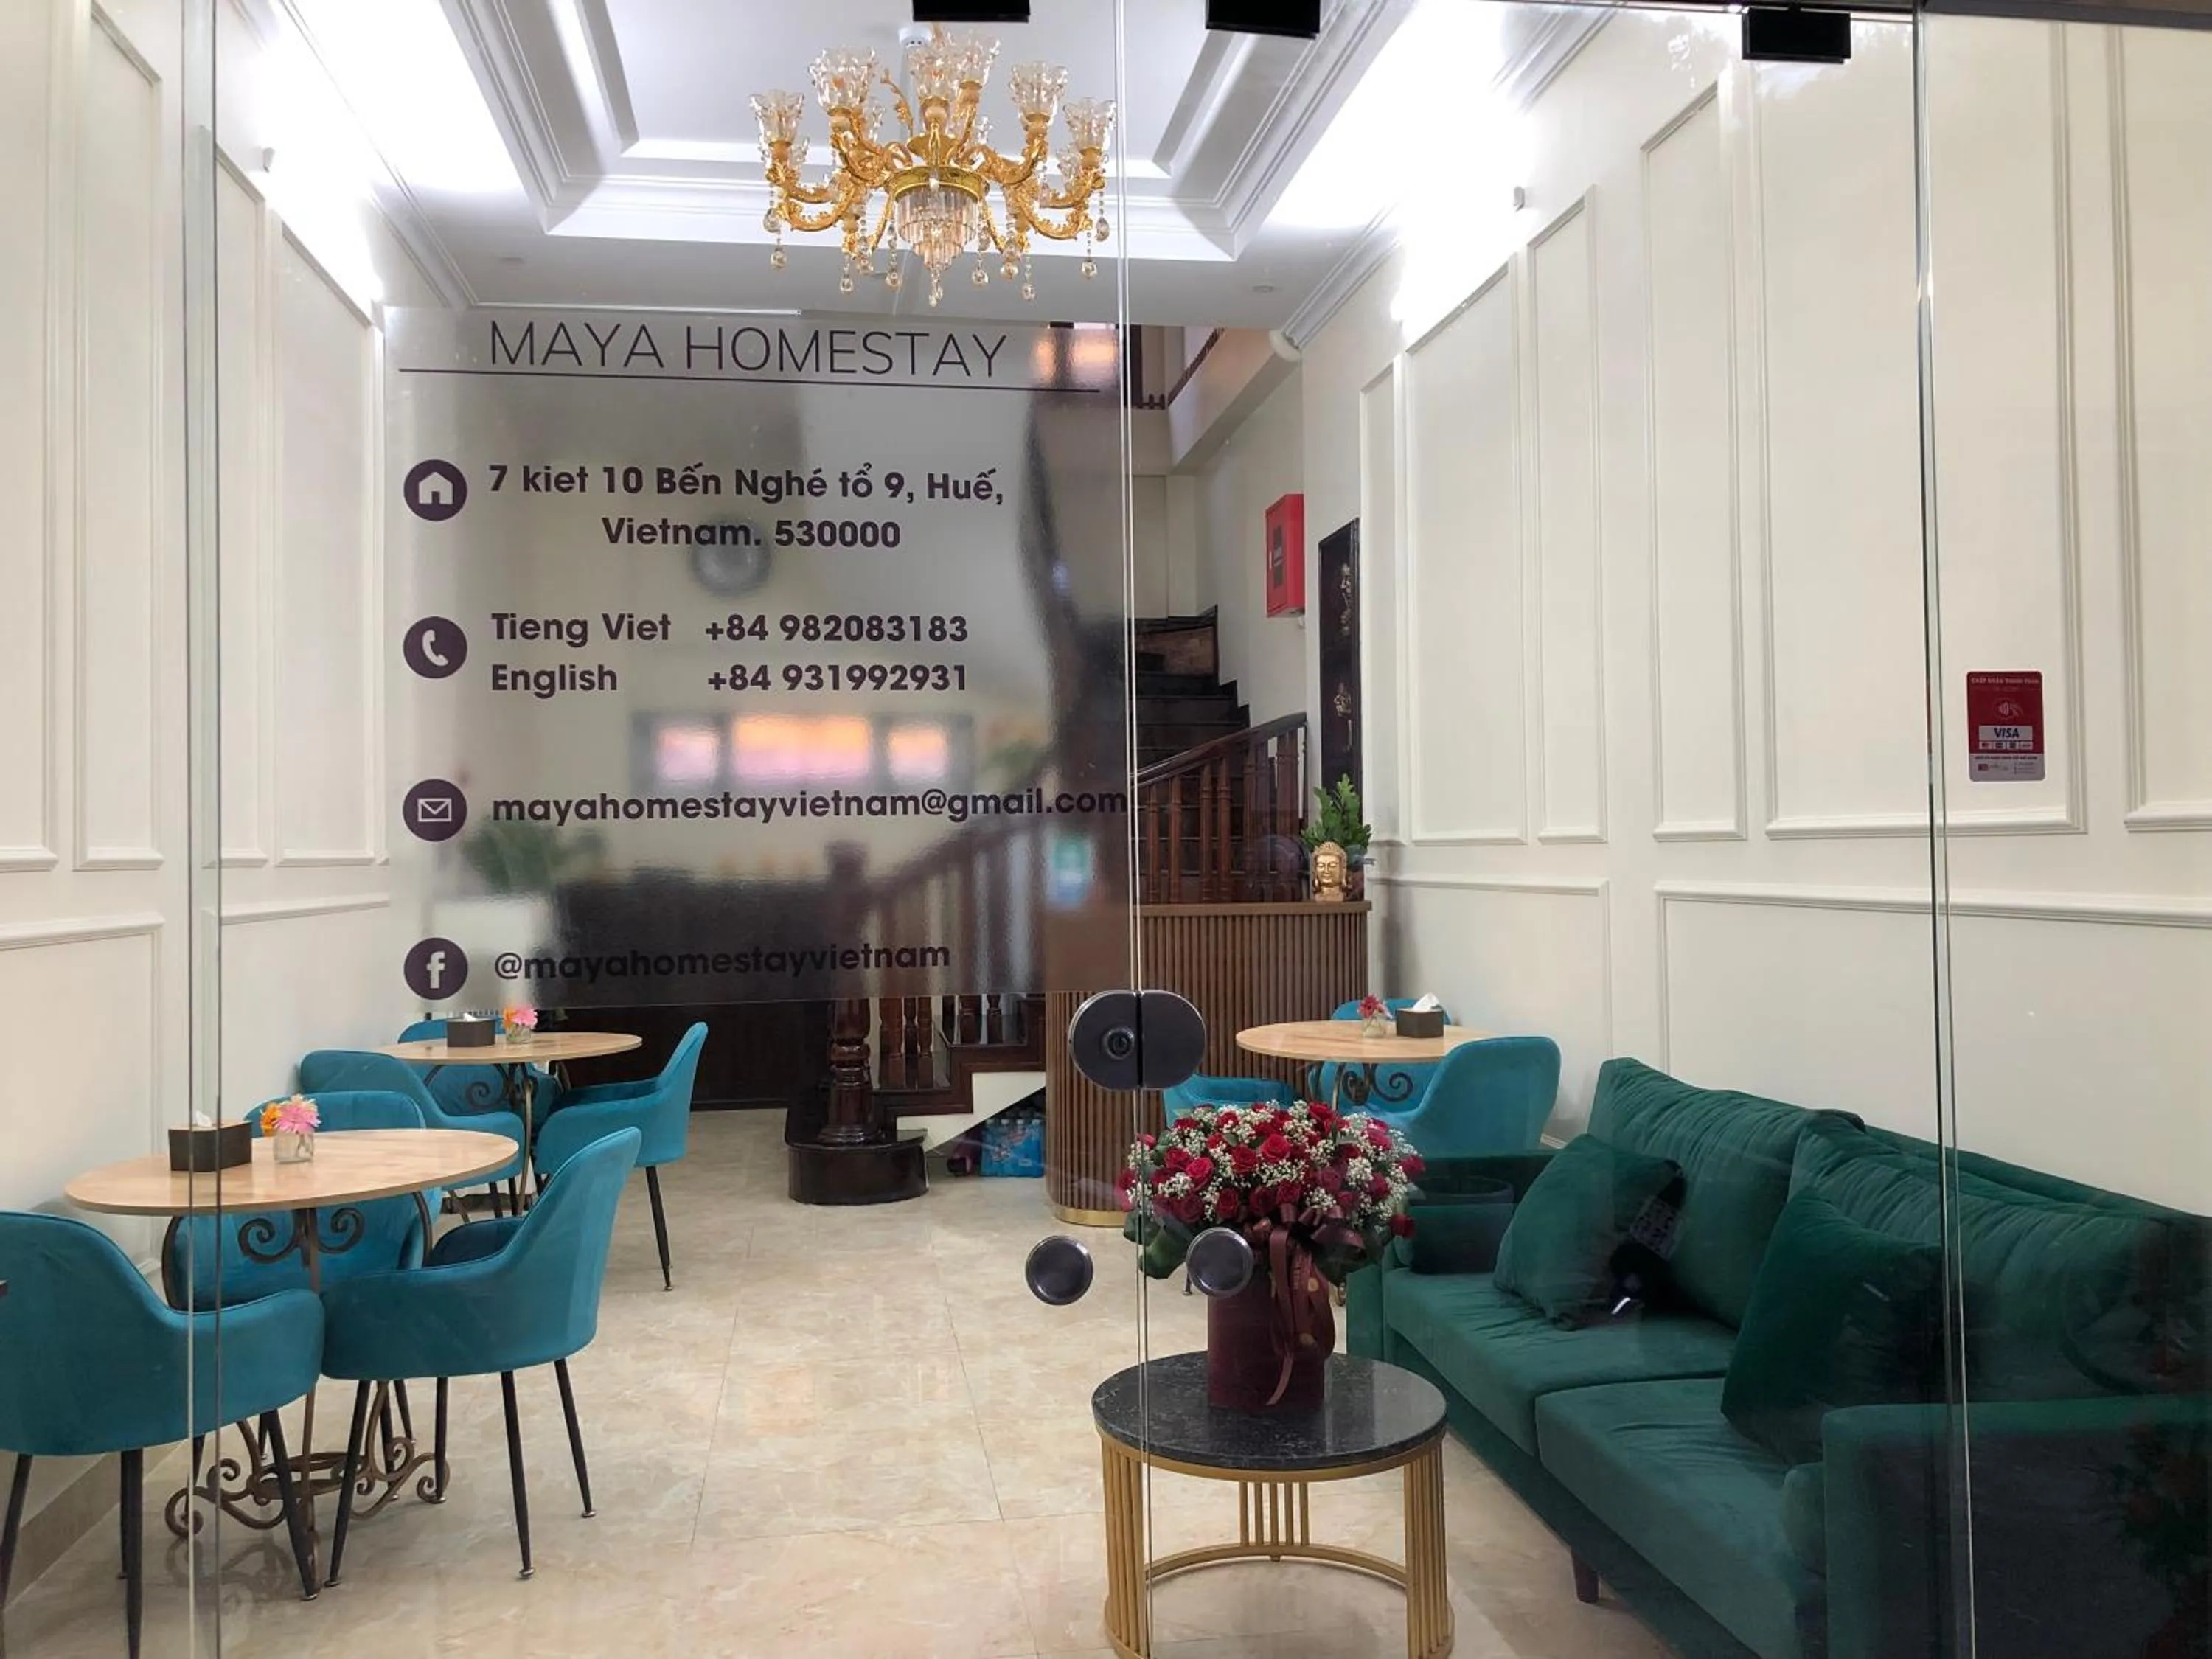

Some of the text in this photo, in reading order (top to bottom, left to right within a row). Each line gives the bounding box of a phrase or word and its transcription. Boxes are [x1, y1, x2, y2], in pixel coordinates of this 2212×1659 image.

[490, 320, 1008, 378] MAYA HOMESTAY
[489, 462, 1004, 505] 7 kiet 10 Bến Nghé tổ 9, Huế,
[601, 517, 901, 549] Vietnam. 530000
[490, 612, 969, 647] Tieng Viet +84 982083183
[491, 664, 967, 699] English +84 931992931
[1994, 728, 2020, 738] VISA
[492, 787, 1128, 826] mayahomestayvietnam@gmail.com
[494, 942, 950, 983] @mayahomestayvietnam
